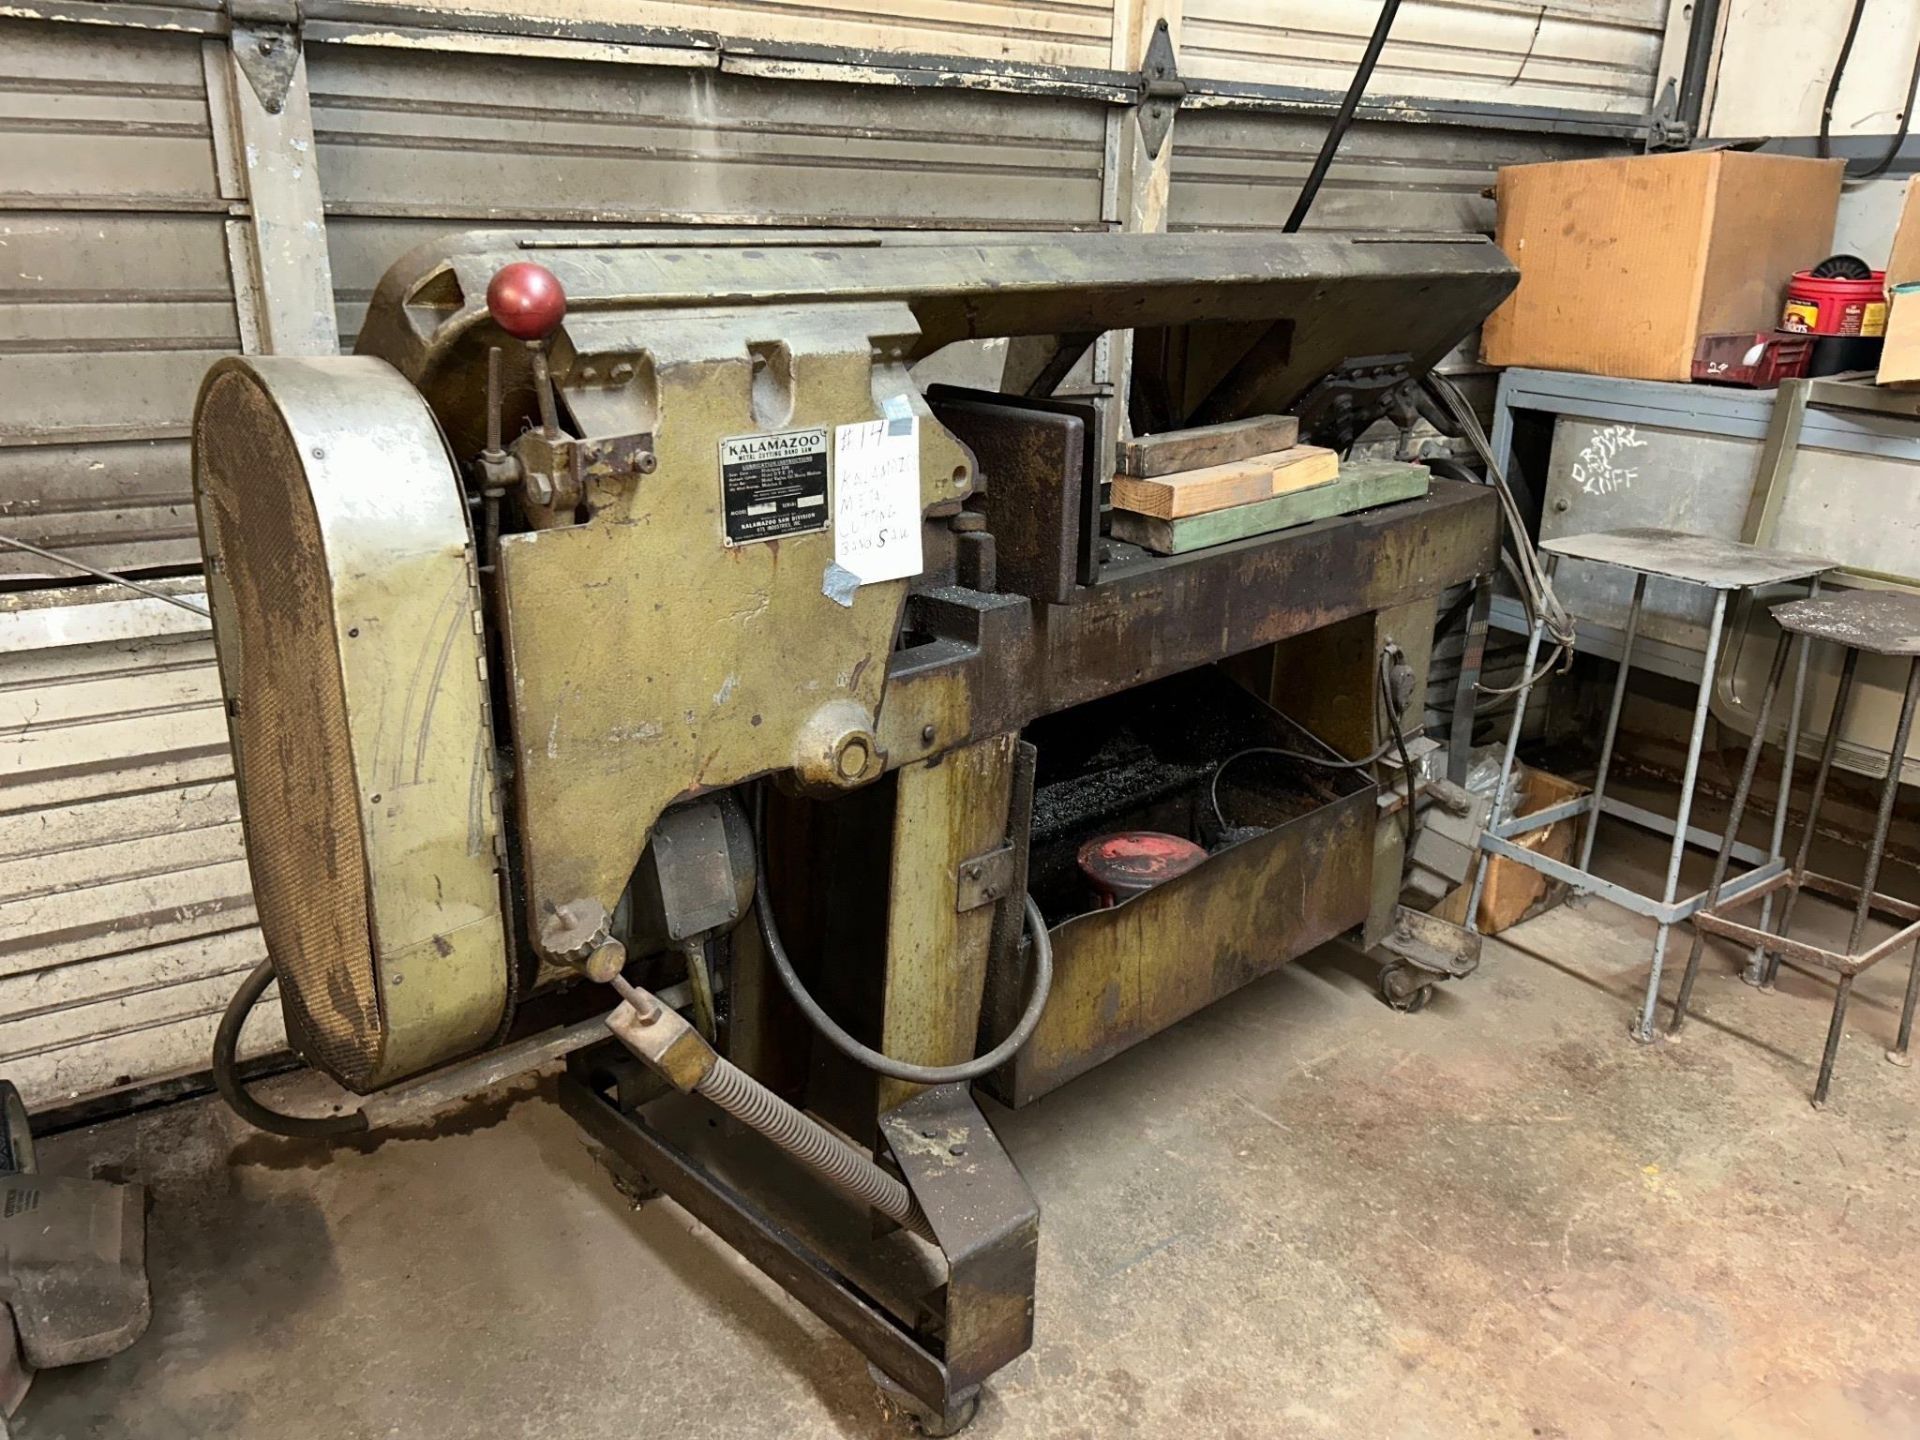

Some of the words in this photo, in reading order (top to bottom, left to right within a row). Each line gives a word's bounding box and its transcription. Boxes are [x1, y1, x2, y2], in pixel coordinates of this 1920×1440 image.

[729, 435, 820, 456] KALAMAZOO
[739, 453, 756, 461] METAL
[759, 450, 782, 458] CUTTING
[801, 446, 812, 454] SAW
[741, 519, 777, 530] KALAMAZOO
[778, 516, 790, 524] SAW
[791, 512, 815, 521] DIVISION
